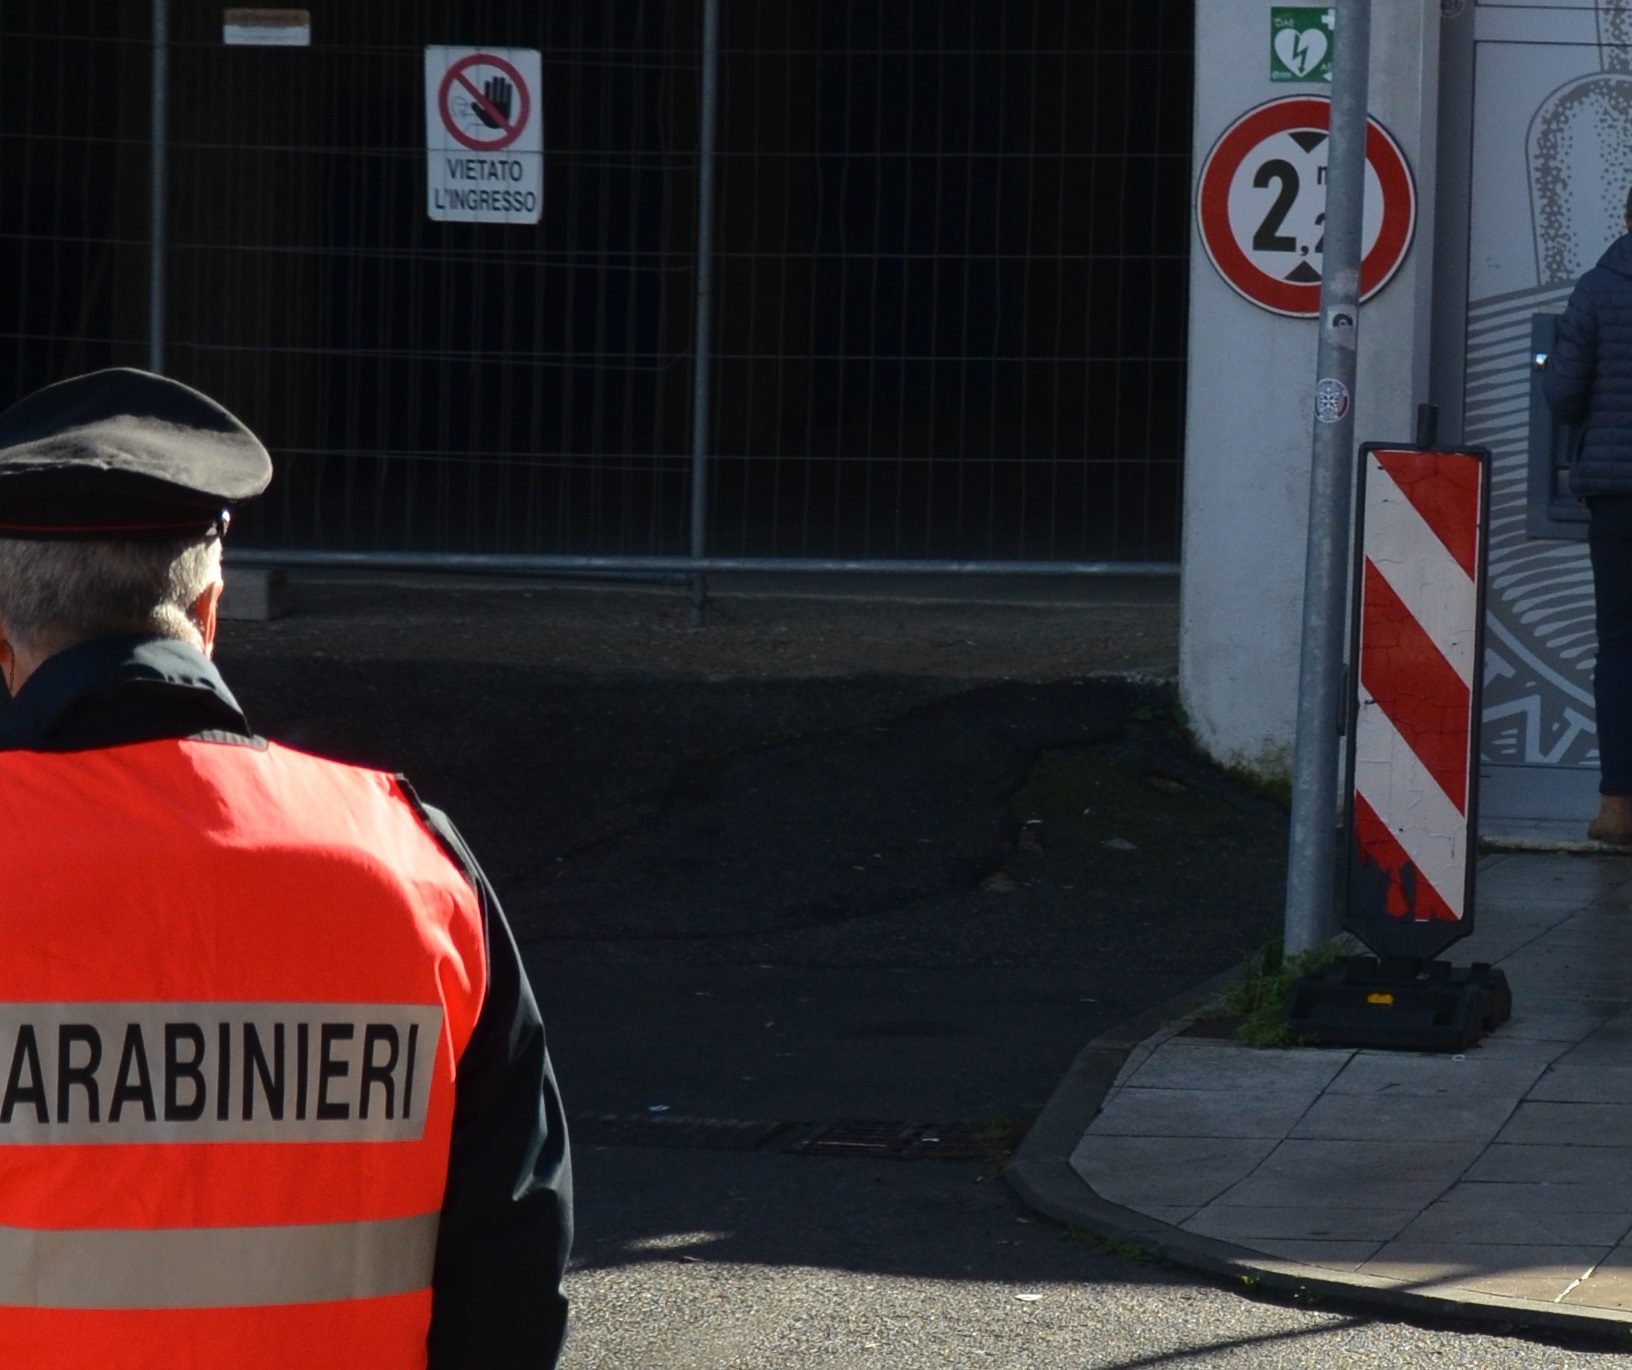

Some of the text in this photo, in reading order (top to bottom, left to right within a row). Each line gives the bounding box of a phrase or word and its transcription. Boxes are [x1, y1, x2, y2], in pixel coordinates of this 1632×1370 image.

[447, 159, 523, 182] VIETATO
[434, 188, 536, 213] L'INGRESSO
[0, 1022, 419, 1123] ARABINIERI
